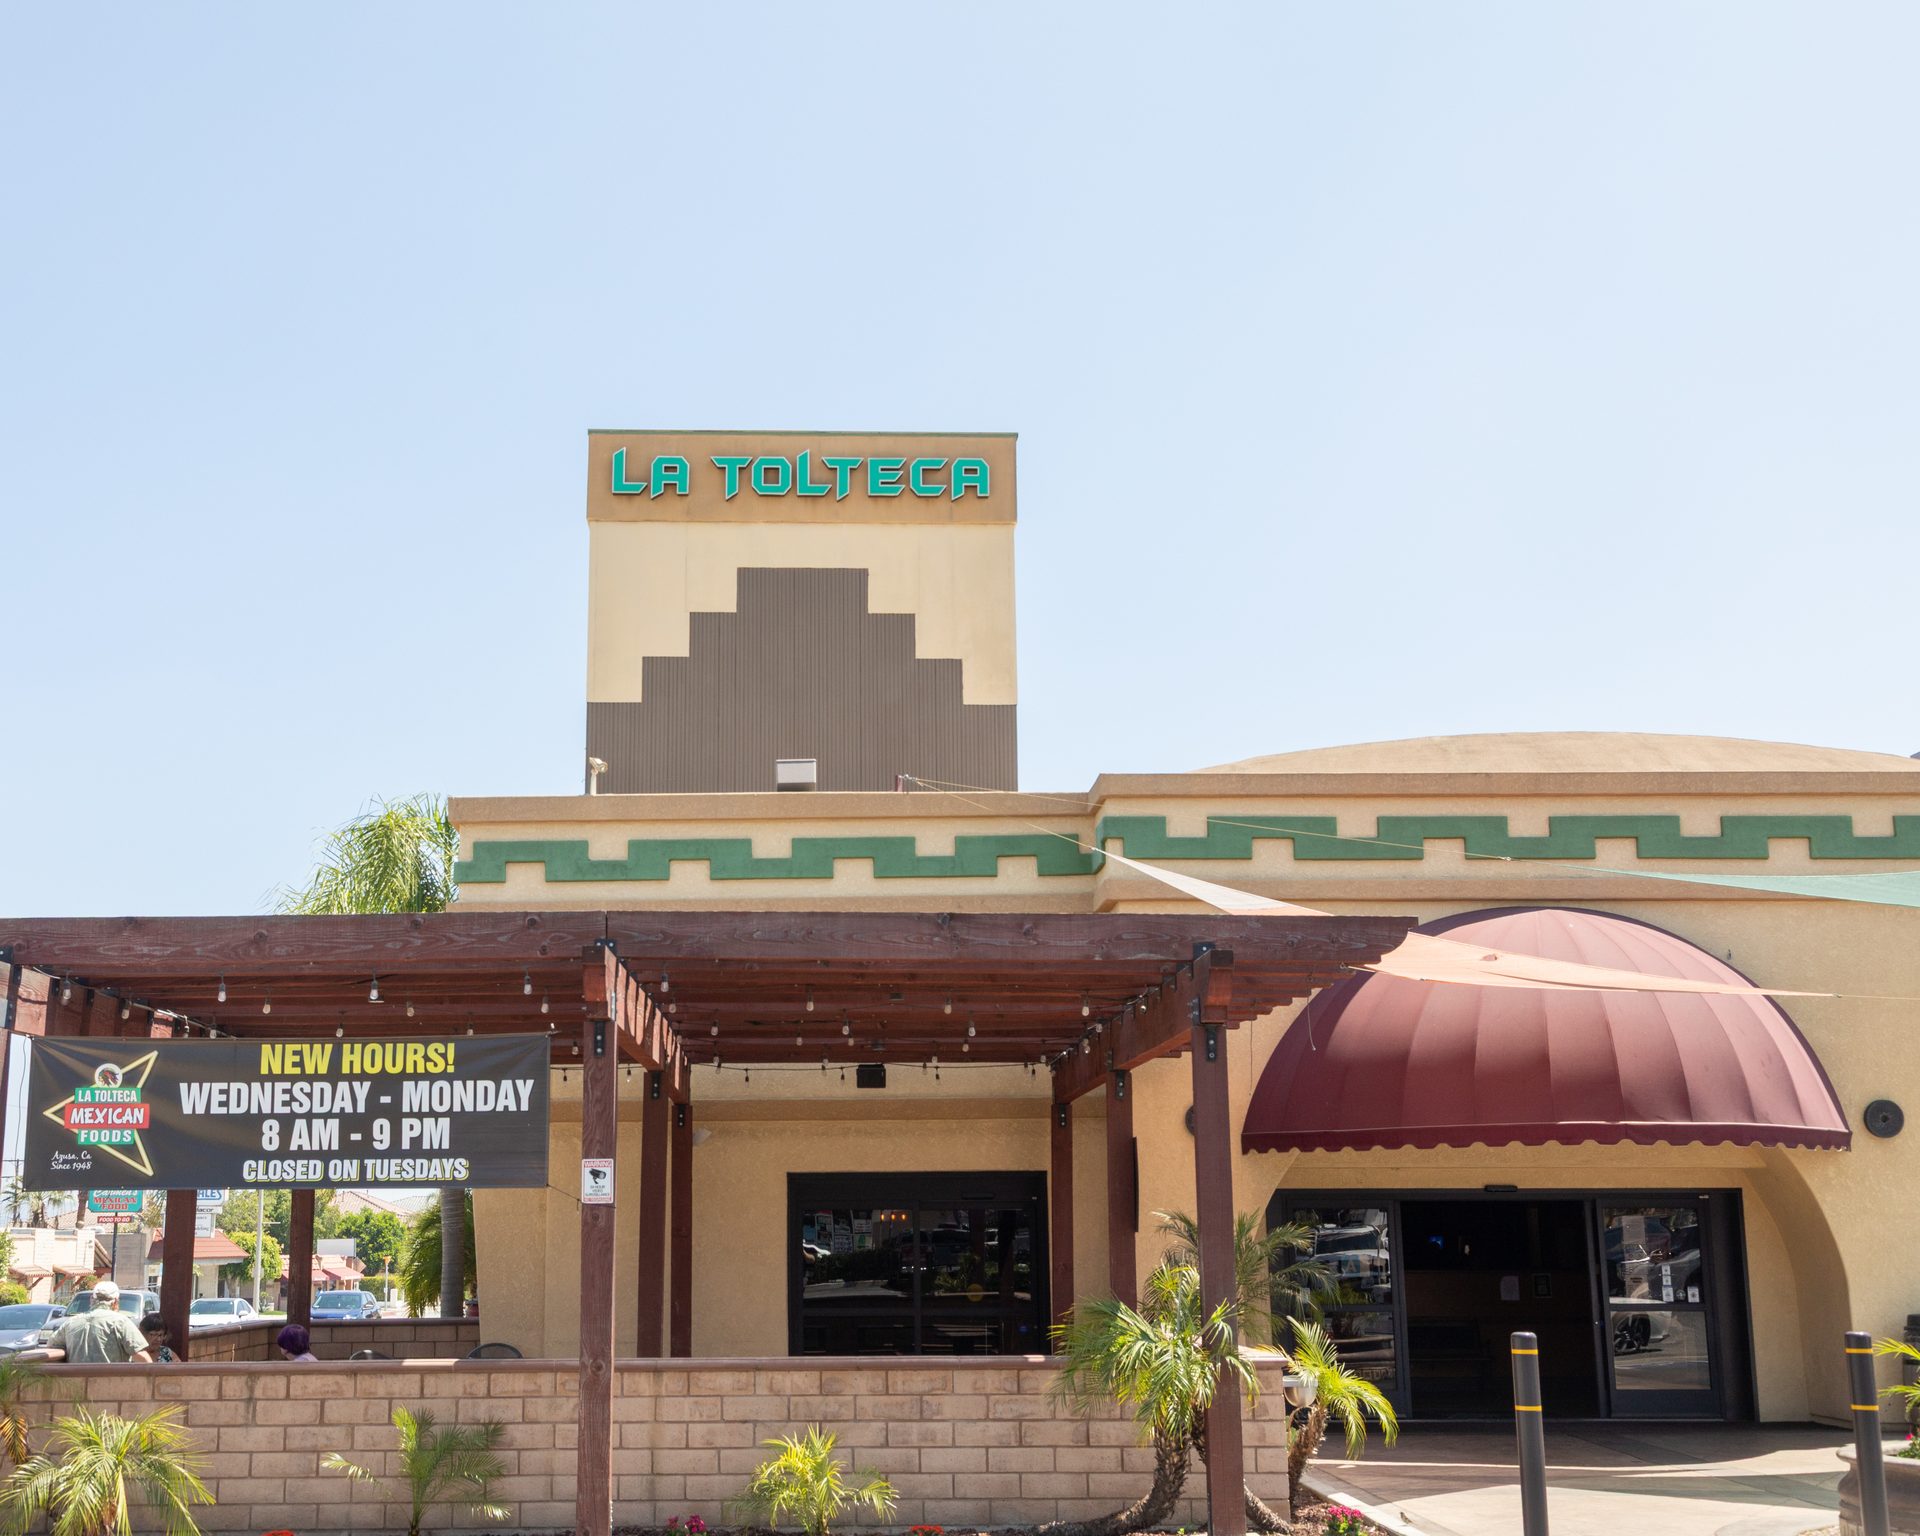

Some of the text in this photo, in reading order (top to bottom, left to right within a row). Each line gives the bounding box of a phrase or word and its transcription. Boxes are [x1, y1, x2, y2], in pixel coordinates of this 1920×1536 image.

[612, 447, 991, 501] LA TOLTECA
[260, 1042, 455, 1075] NEW HOURS!
[78, 1090, 137, 1102] LA TOLTECA
[179, 1081, 372, 1115] WEDNESDAY
[402, 1079, 535, 1113] MONDAY
[70, 1107, 145, 1125] MEXICAN
[80, 1130, 132, 1143] FOODS
[261, 1119, 280, 1151] 8
[289, 1118, 340, 1151] AM
[372, 1118, 391, 1150] 9
[401, 1117, 450, 1150] PM
[50, 1161, 93, 1170] Since 1948
[51, 1150, 92, 1163] Azusa, Ca
[243, 1158, 469, 1182] CLOSED ON TUESDAYS
[1346, 1260, 1357, 1272] A
